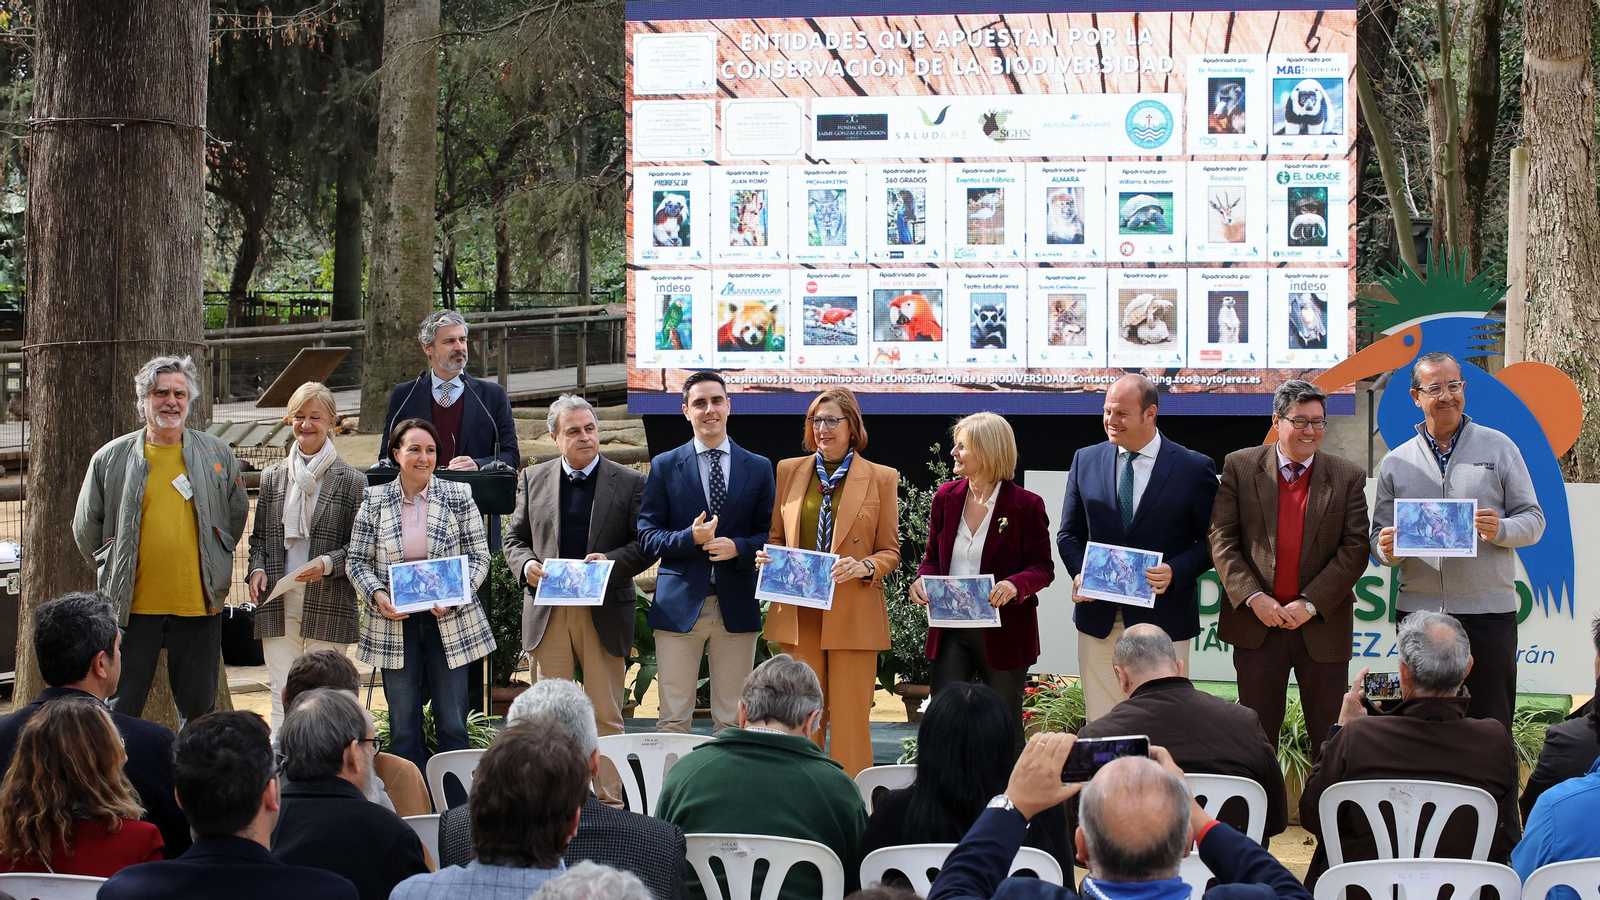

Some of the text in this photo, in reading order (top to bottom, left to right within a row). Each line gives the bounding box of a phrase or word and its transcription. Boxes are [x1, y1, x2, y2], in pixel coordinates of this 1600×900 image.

[741, 28, 1154, 52] ENTIDADES QUE APUESTAN POR LA
[720, 55, 905, 80] CONSERVACIÓN
[915, 56, 942, 76] DE
[953, 56, 981, 75] LA
[990, 55, 1174, 75] BIODIVERSIDAD
[1292, 172, 1340, 181] EL DUENDE
[656, 283, 691, 292] indeso
[1290, 281, 1326, 291] indeso
[780, 376, 790, 384] tu
[792, 376, 852, 385] compromiso
[872, 375, 881, 383] la
[962, 375, 975, 383] de
[977, 375, 987, 383] la
[989, 374, 1069, 383] BIODIVERSIDAD.
[1516, 644, 1555, 664] rán
